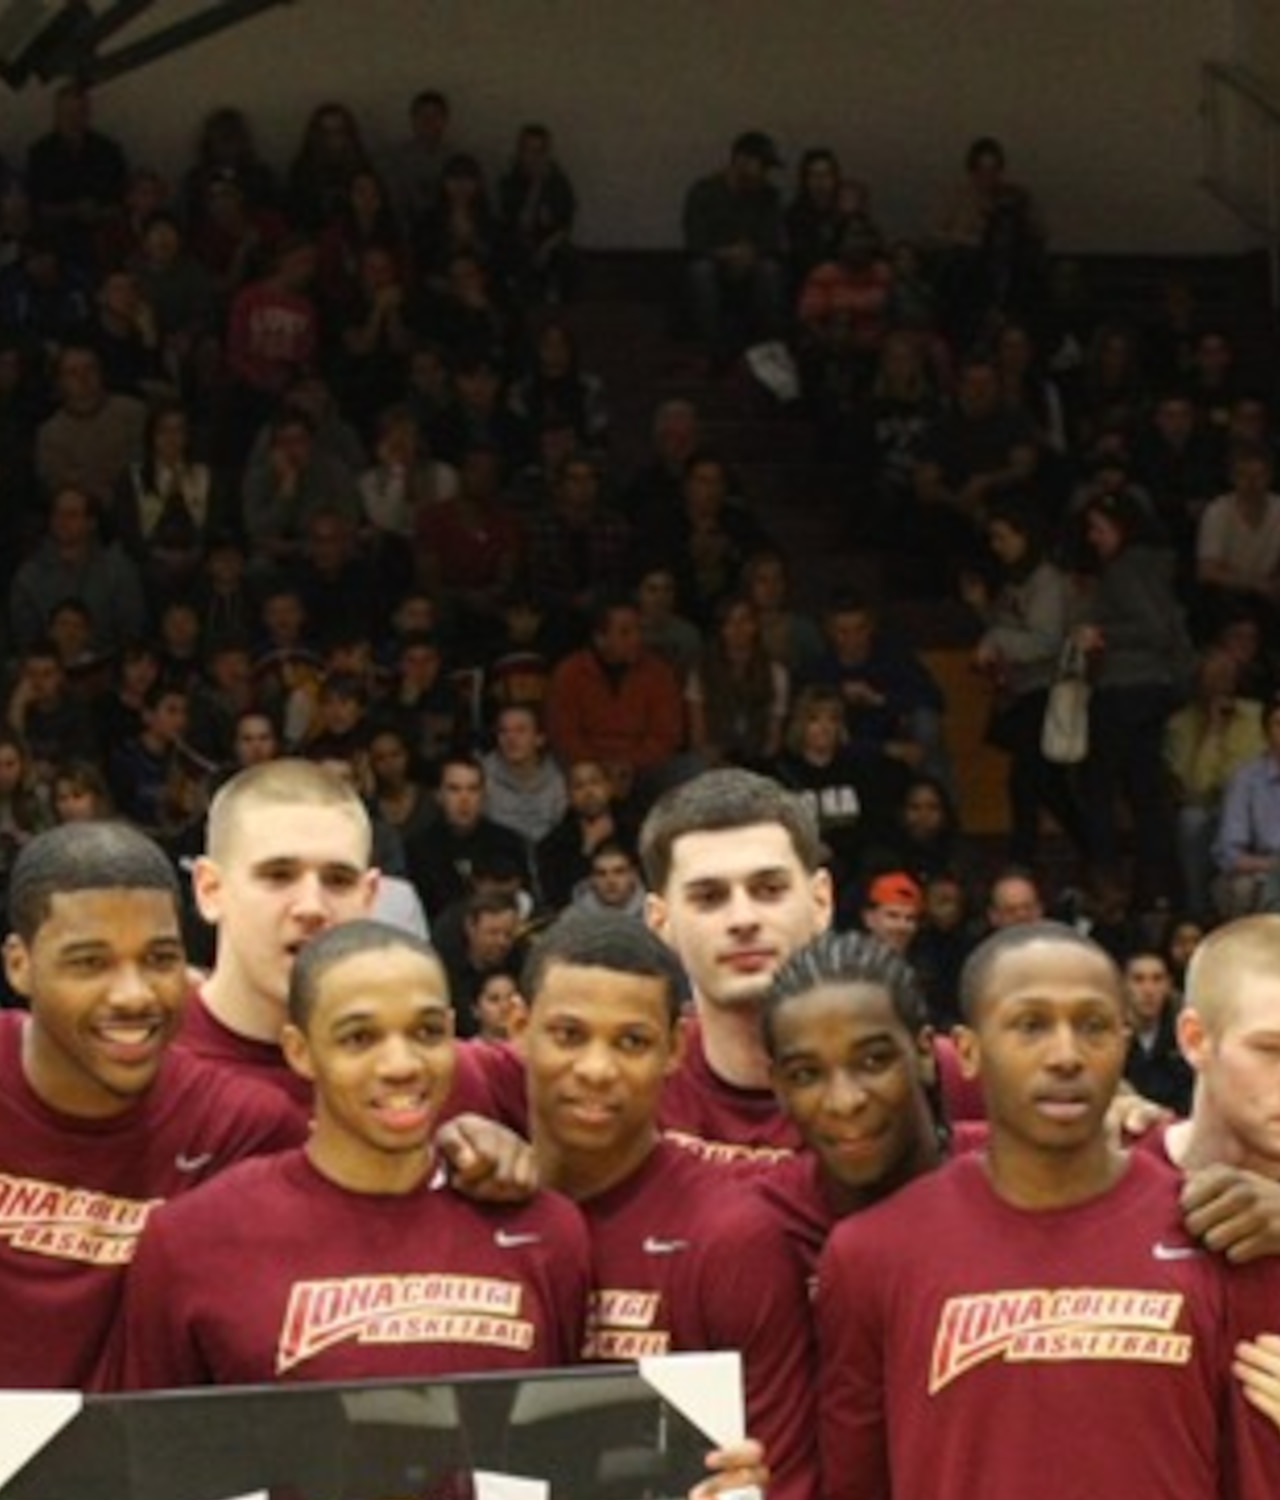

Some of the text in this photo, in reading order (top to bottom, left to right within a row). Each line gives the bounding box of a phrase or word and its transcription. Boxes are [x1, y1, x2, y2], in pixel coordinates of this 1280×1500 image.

[282, 1279, 516, 1361] IONA COLLEGE
[364, 1316, 533, 1346] BASKETBALL
[932, 1293, 1173, 1381] IONA COLLEGE
[1011, 1332, 1187, 1359] BASKETBALL
